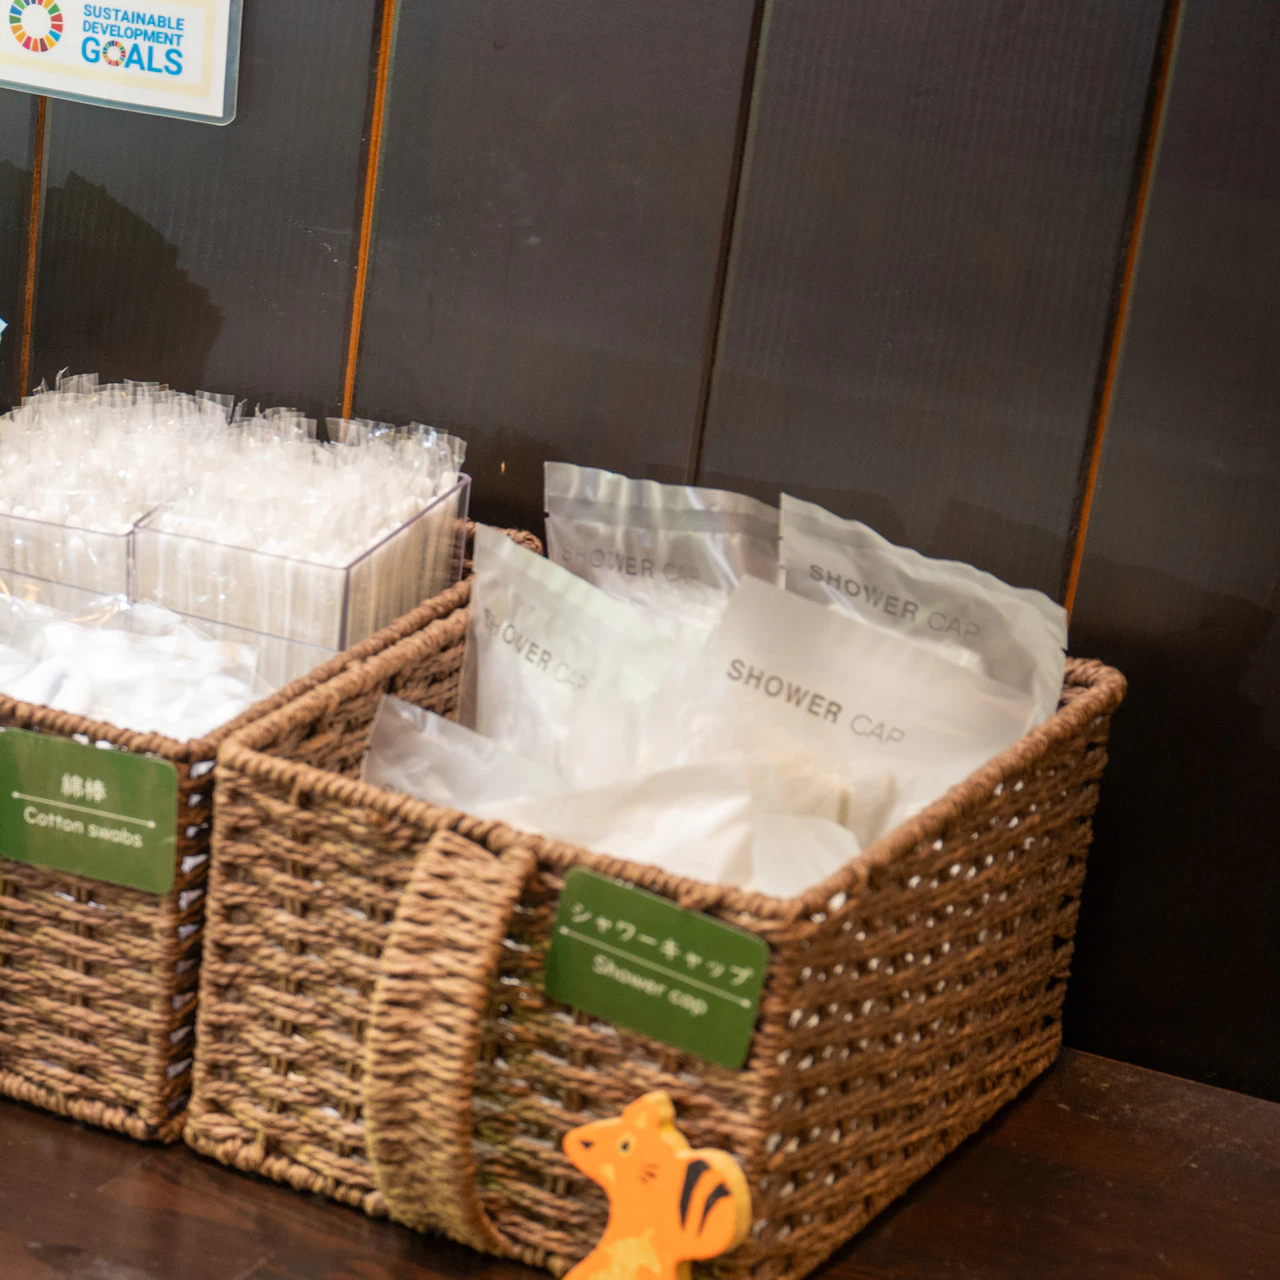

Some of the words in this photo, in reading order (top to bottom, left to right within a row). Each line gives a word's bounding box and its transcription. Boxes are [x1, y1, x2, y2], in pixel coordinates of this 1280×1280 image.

[82, 19, 184, 46] DEVELOPMENT
[83, 4, 184, 30] SUSTAINABLE
[81, 36, 184, 76] GOALS
[560, 541, 655, 583] SHOWER
[659, 555, 702, 585] CAP
[808, 562, 920, 624] SHOWER
[924, 609, 982, 642] CAP
[554, 653, 590, 693] CAP
[726, 657, 845, 726] SHOWER
[849, 713, 907, 747] CAP
[60, 772, 107, 803] 綿棒
[23, 806, 84, 835] Cotton
[87, 824, 143, 848] swabs
[569, 902, 754, 988] シャワーキャップ
[592, 954, 664, 1002] Shower
[667, 982, 709, 1018] cap
